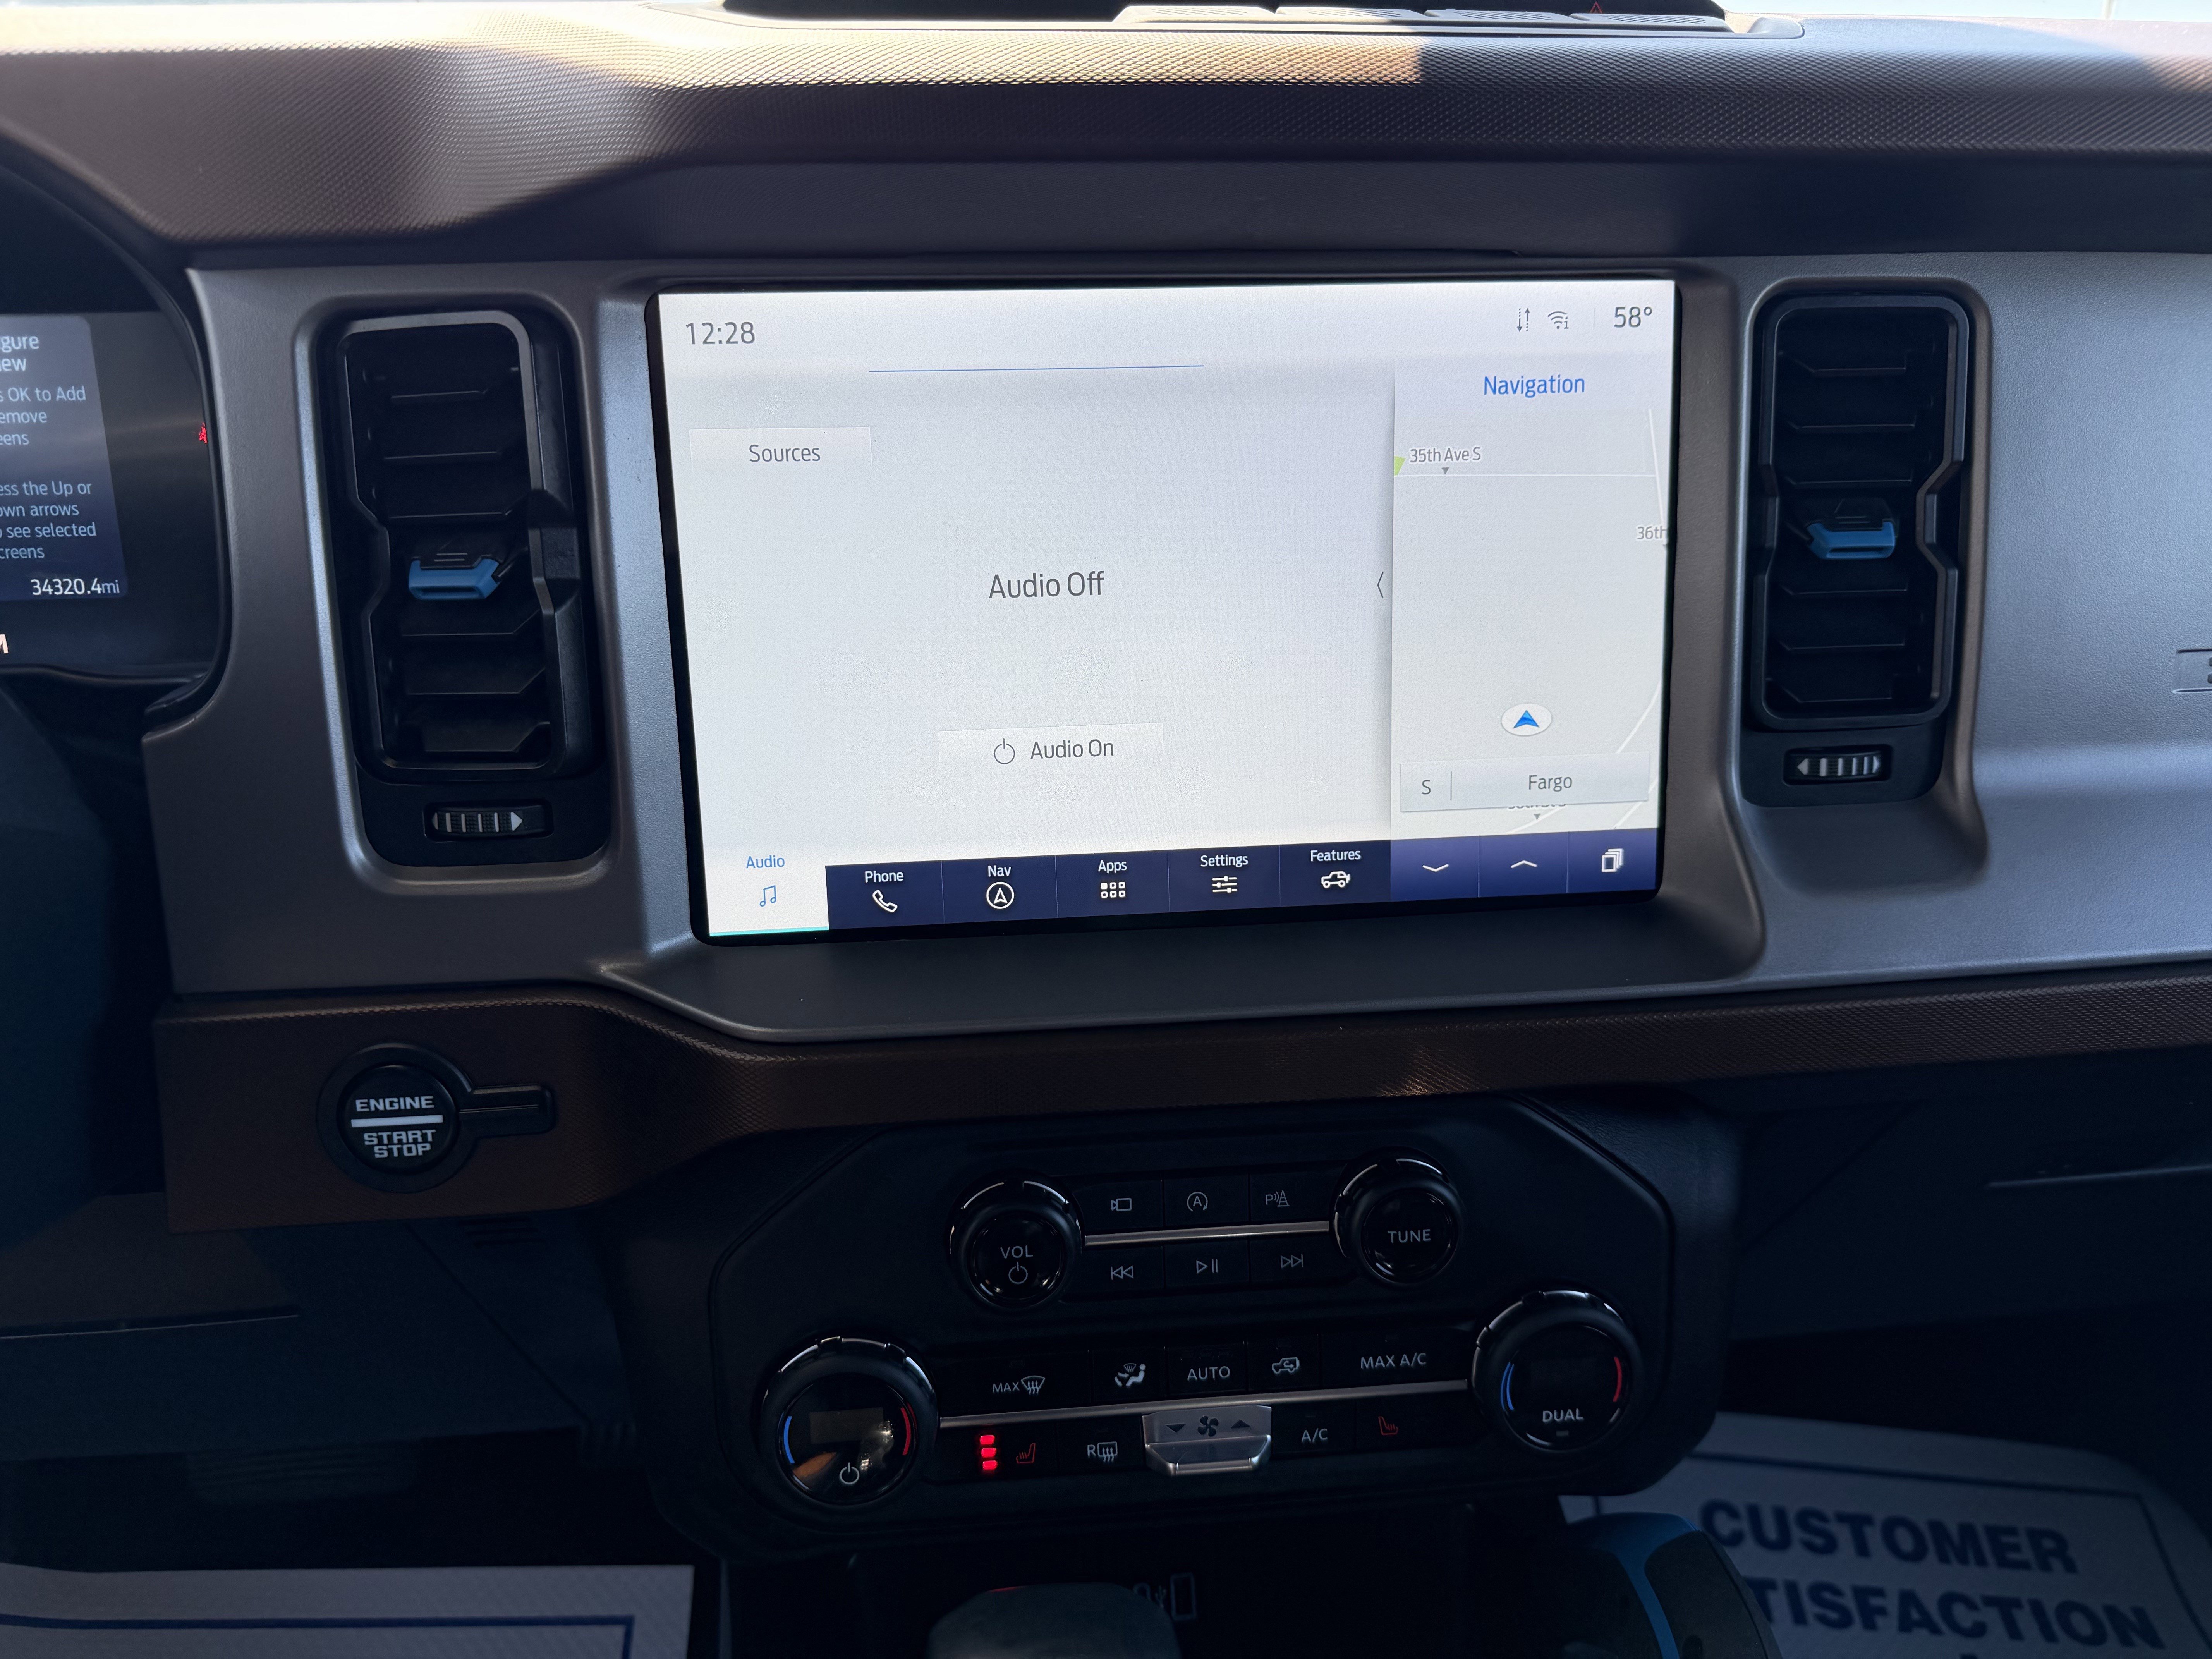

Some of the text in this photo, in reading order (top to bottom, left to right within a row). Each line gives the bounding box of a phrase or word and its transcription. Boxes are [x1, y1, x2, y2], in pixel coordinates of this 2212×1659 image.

[1614, 306, 1652, 328] 58°
[686, 322, 755, 345] 12:28
[0, 358, 26, 372] ew
[7, 387, 31, 402] OK
[35, 388, 51, 401] to
[56, 386, 86, 401] Add
[1484, 374, 1585, 398] Navigation
[0, 434, 29, 445] ens
[749, 444, 821, 462] Sources
[1410, 447, 1481, 463] 35th Ave S
[22, 481, 48, 495] the
[52, 481, 73, 497] Up
[77, 483, 91, 495] or
[30, 505, 79, 516] arrows
[6, 527, 31, 538] see
[34, 522, 96, 538] selected
[989, 570, 1104, 599] Audio Off
[1030, 739, 1114, 759] Audio On
[1422, 775, 1572, 795] S Fargo
[746, 855, 785, 869] Audio
[1200, 854, 1249, 867] Settings
[1310, 850, 1361, 862] Features
[988, 865, 1011, 877] Nav
[1098, 860, 1127, 874] Apps
[865, 870, 904, 883] Phone
[356, 1096, 434, 1112] ENGINE
[363, 1128, 436, 1146] START
[373, 1142, 432, 1158] STOP
[1387, 1229, 1431, 1243] TUNE
[1000, 1245, 1033, 1259] VOL
[1360, 1353, 1426, 1369] MAX A/C
[1187, 1366, 1230, 1381] AUTO
[993, 1382, 1020, 1393] MAX
[1542, 1408, 1583, 1422] DUAL
[1301, 1428, 1328, 1442] A/C
[1701, 1500, 2078, 1573] CUSTOMER
